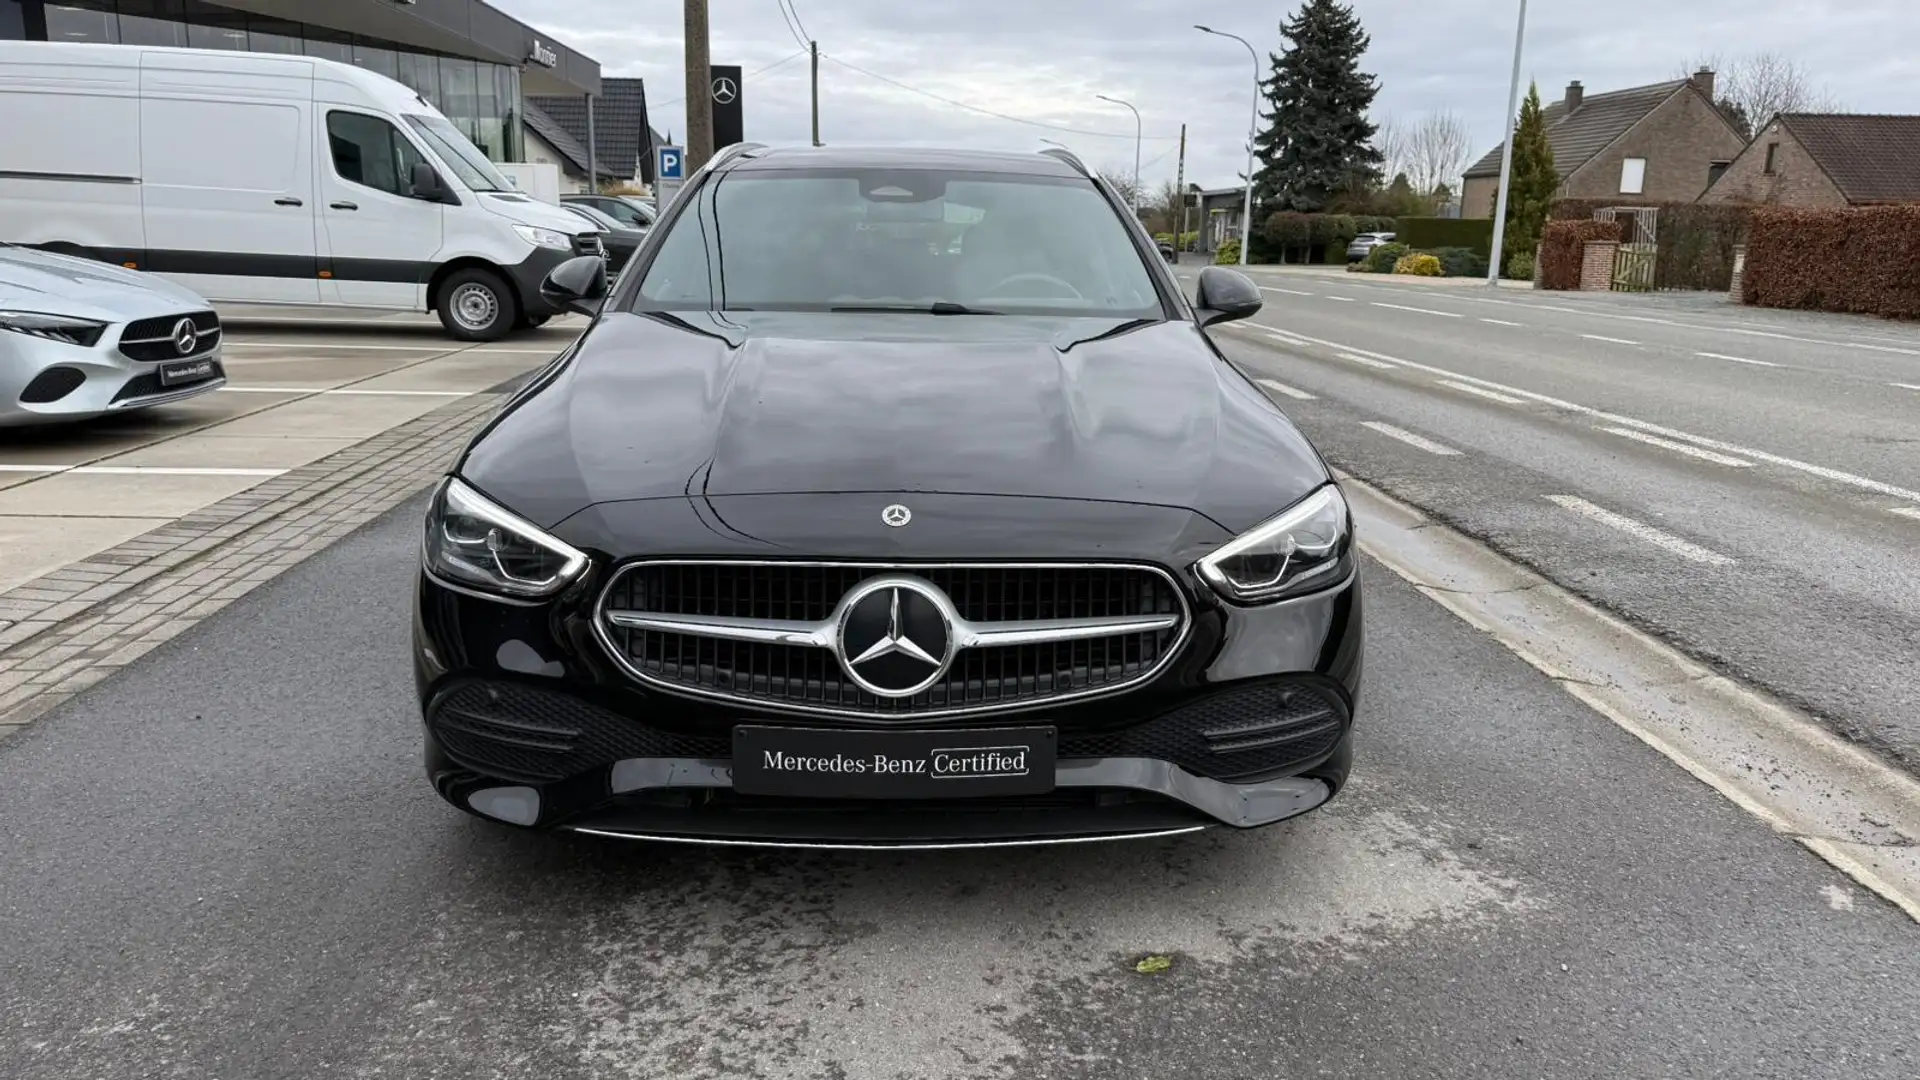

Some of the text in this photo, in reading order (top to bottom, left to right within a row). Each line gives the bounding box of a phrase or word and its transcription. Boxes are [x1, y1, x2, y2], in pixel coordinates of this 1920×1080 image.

[663, 153, 678, 172] P
[763, 751, 1026, 774] Mercedes-Benz Certified
